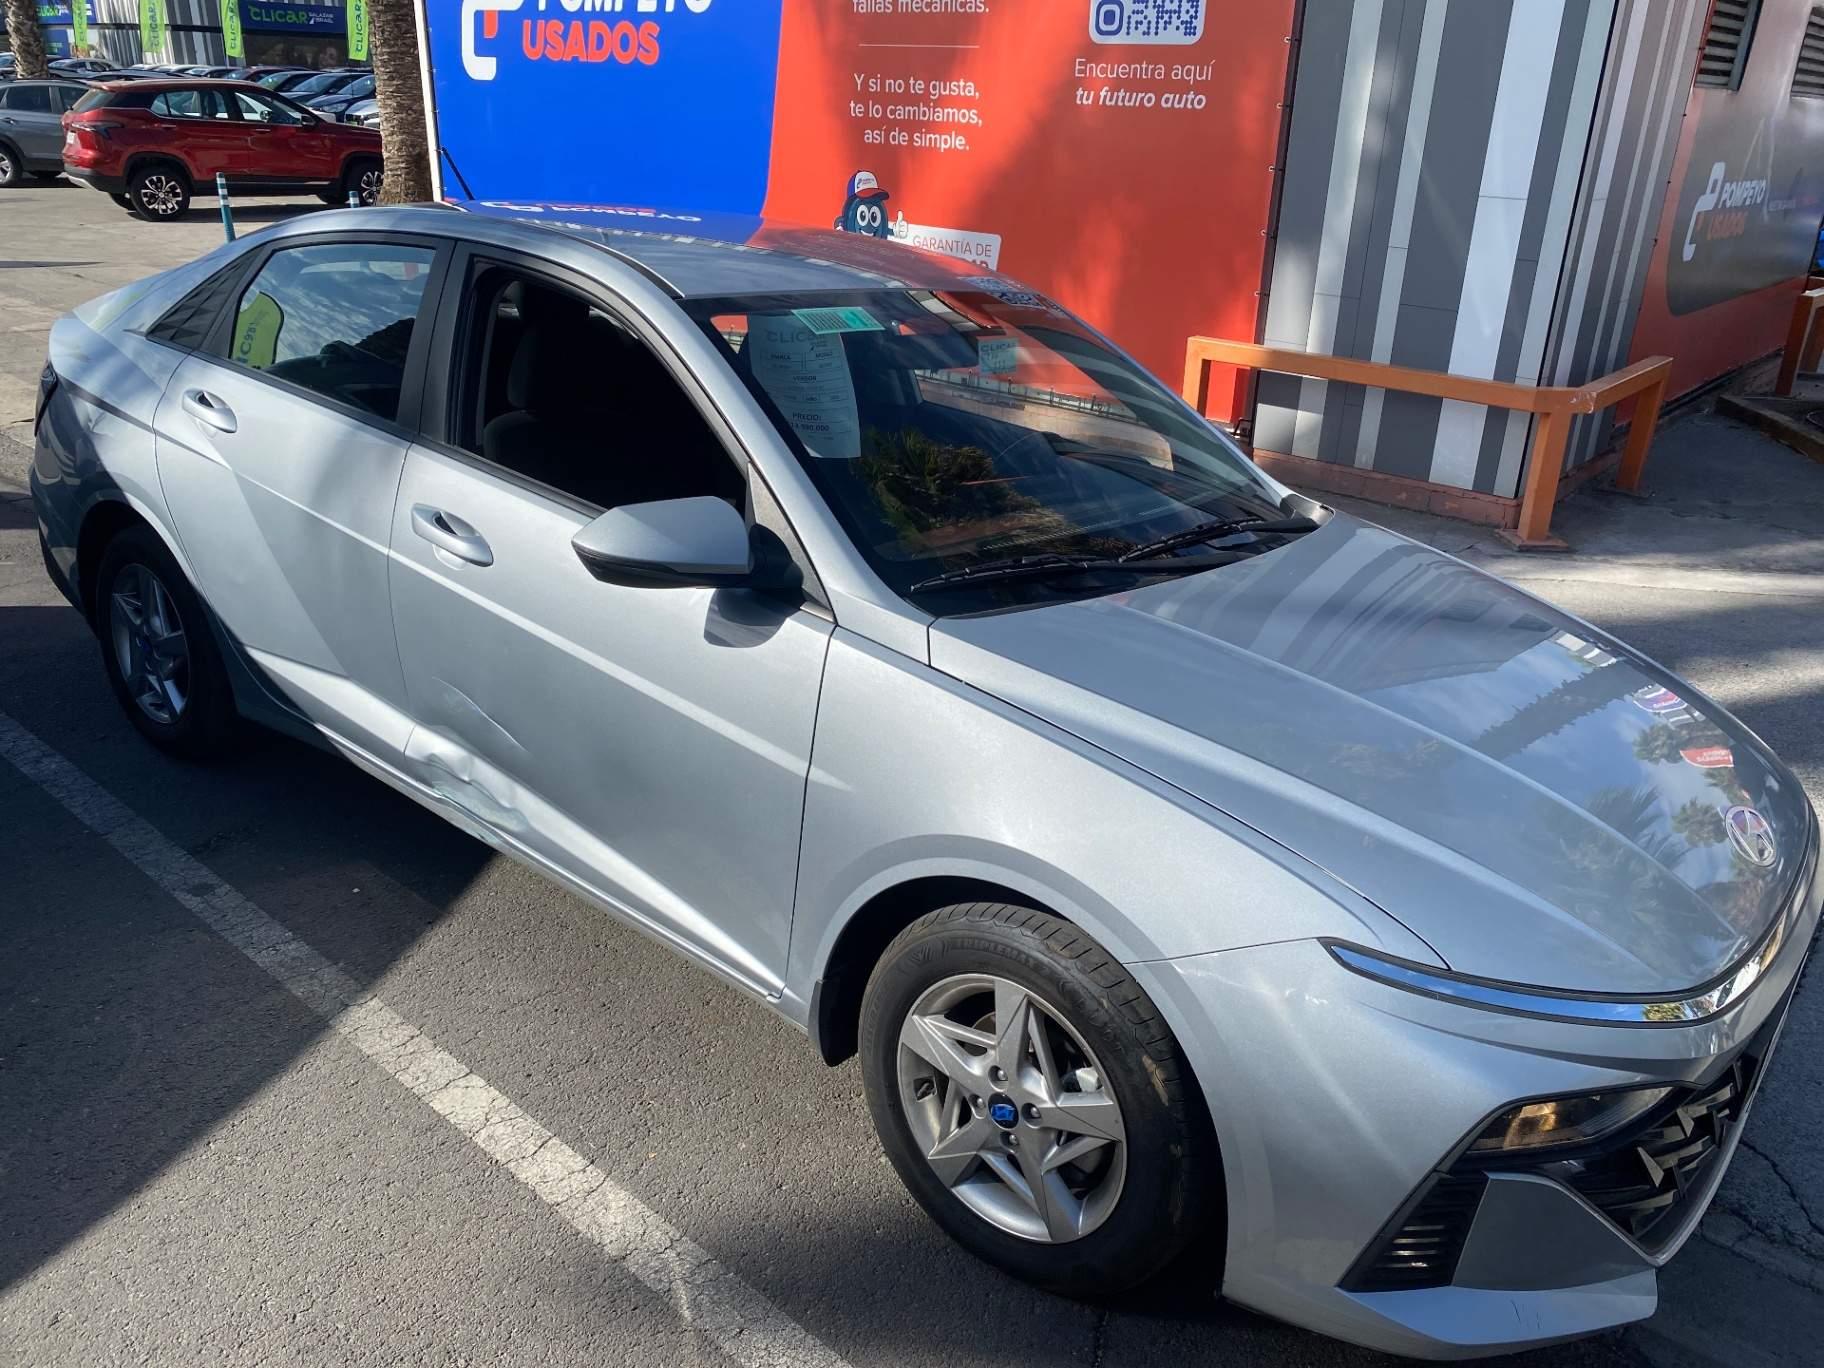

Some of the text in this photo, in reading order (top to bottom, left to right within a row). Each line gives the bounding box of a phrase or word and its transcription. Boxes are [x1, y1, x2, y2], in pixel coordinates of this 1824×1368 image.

[522, 19, 661, 66] USADOS
[1074, 58, 1216, 85] Encuentra aquí
[853, 73, 980, 100] Y si no te gusta,
[1076, 86, 1207, 109] tu futuro auto
[849, 100, 983, 127] te lo cambiamos,
[863, 125, 970, 152] así de simple.
[912, 234, 992, 258] GARANTÍA DE
